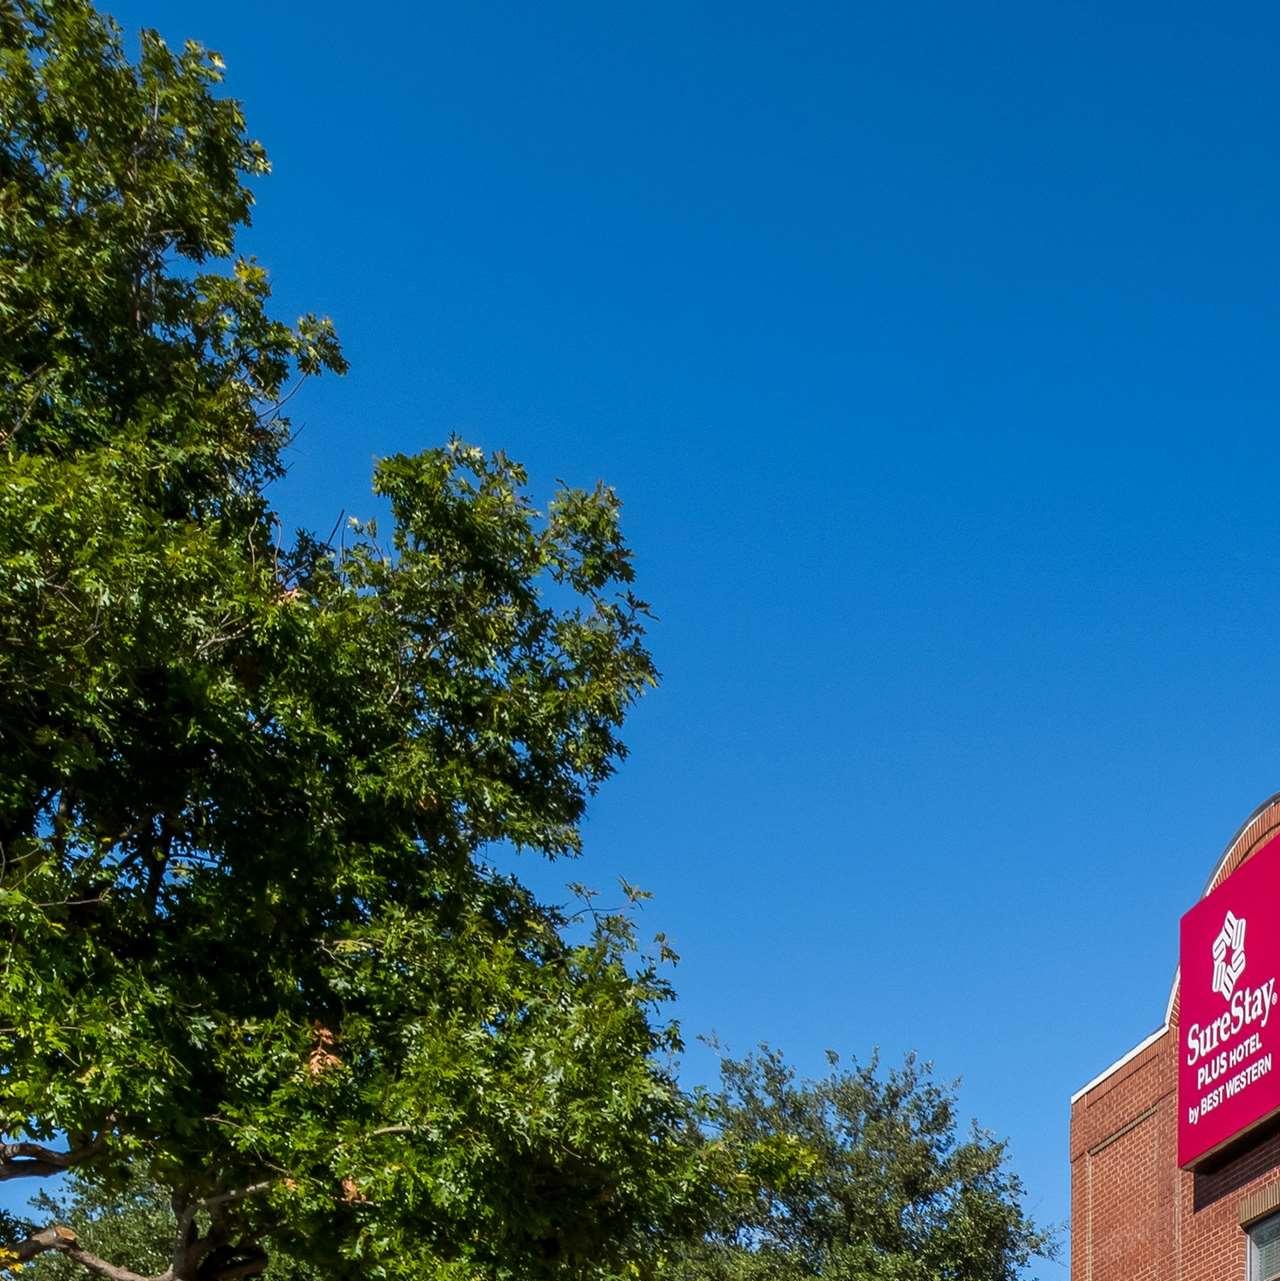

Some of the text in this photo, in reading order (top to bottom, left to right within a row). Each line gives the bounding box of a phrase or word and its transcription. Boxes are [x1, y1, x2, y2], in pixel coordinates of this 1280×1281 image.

[1188, 1053, 1272, 1125] by BEST WESTERN
[1197, 1032, 1263, 1090] PLUS HOTEL
